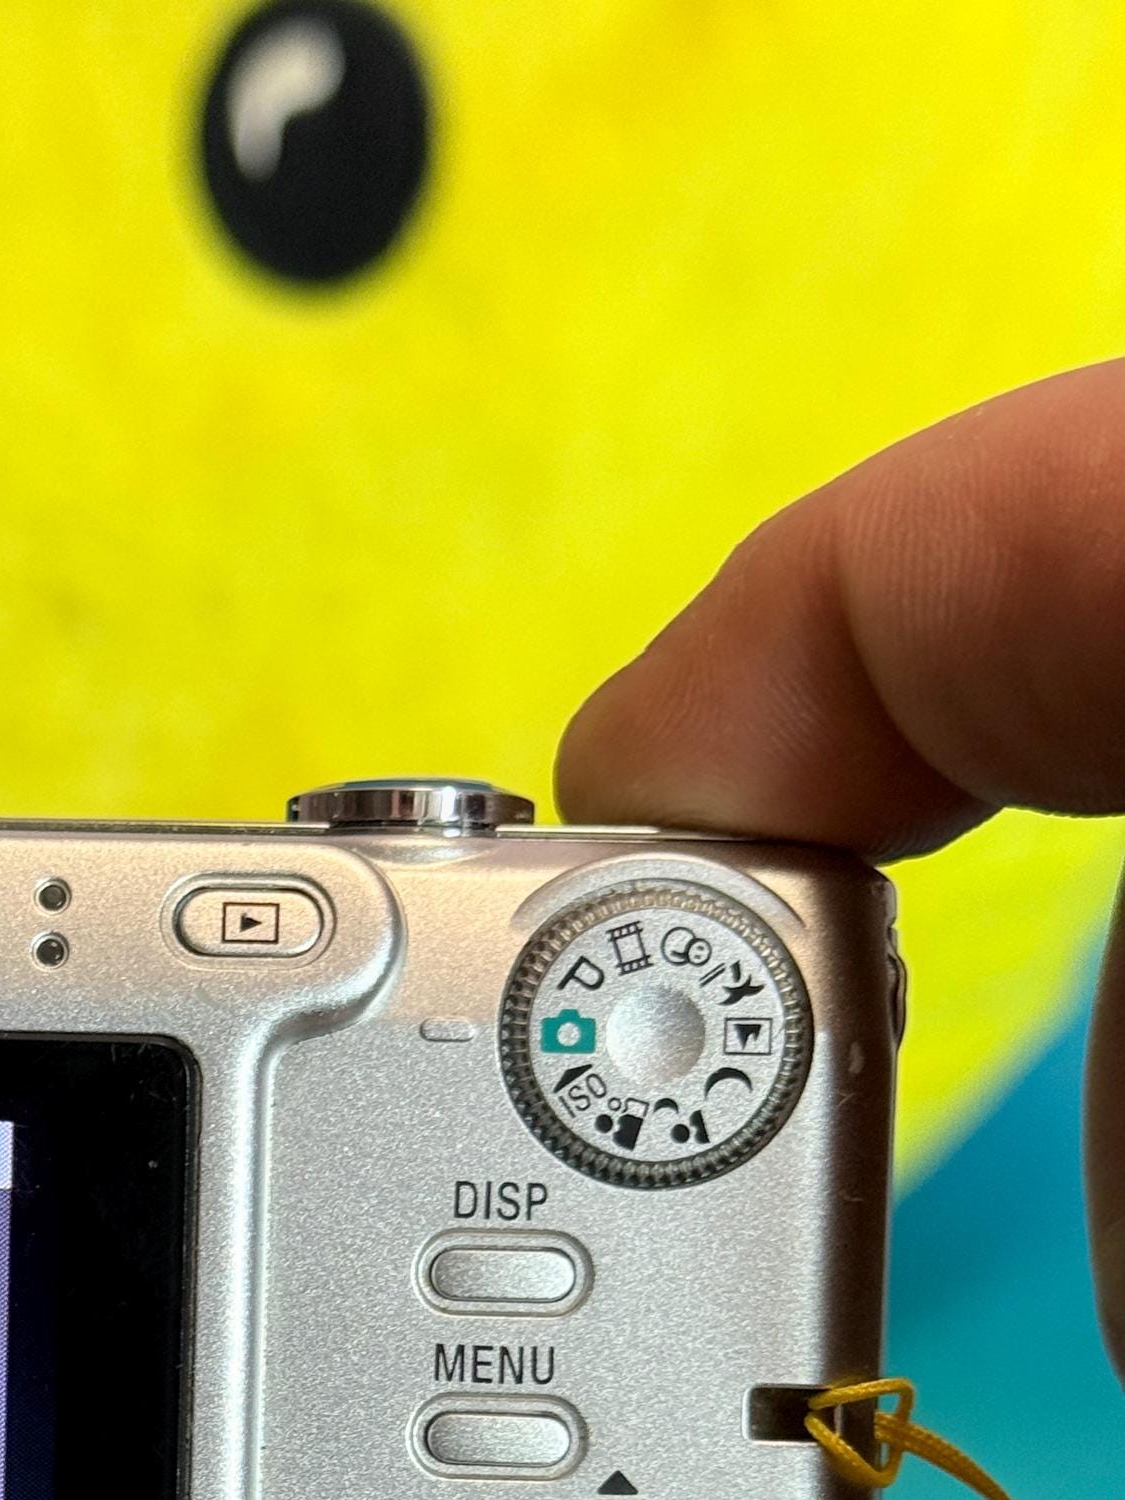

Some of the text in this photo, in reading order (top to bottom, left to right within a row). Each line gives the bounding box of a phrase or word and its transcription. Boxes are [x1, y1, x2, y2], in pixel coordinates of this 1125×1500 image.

[556, 955, 606, 991] P
[558, 1073, 607, 1118] ISO
[453, 1180, 549, 1221] DISP
[433, 1343, 556, 1385] MENU
